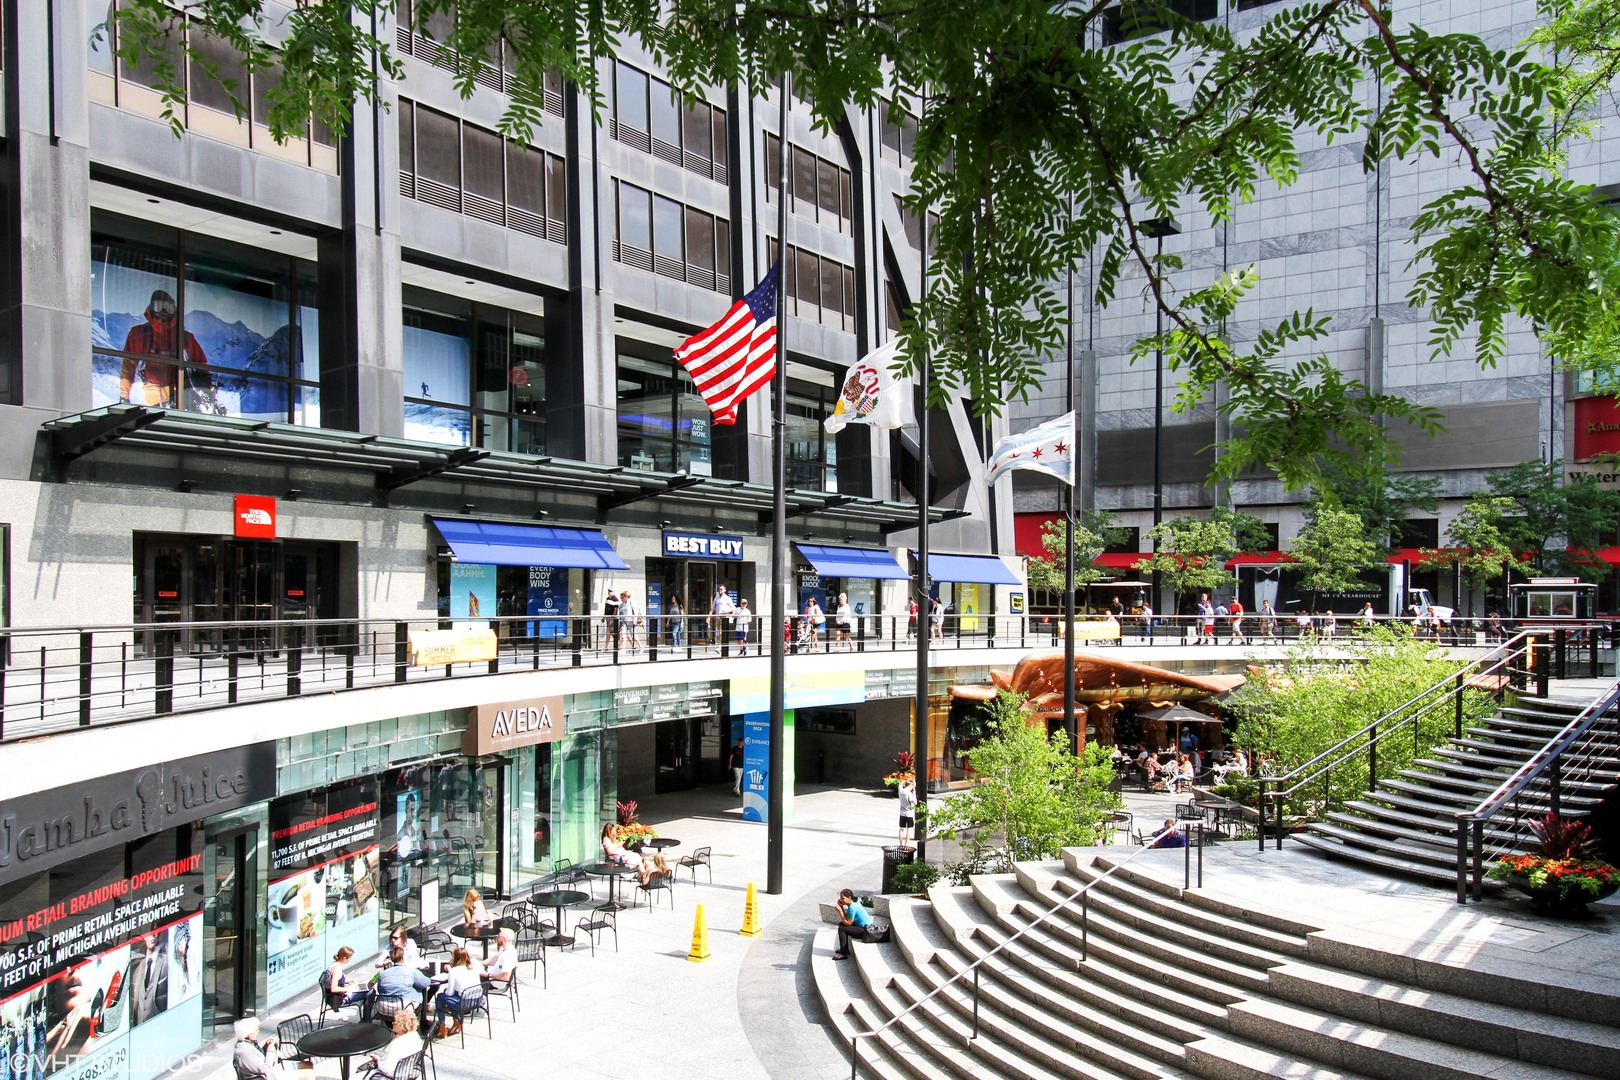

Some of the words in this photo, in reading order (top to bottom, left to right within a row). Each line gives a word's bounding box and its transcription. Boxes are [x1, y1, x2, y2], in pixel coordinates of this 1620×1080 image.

[667, 536, 707, 552] BEST
[710, 539, 742, 554] BUY
[530, 572, 550, 580] BODY
[530, 580, 550, 588] WINS
[425, 645, 456, 657] SUMMER
[615, 689, 649, 699] SOUVENIRS
[492, 704, 553, 738] AVEDA
[0, 795, 133, 867] Jamba
[165, 767, 250, 815] Juice
[272, 825, 298, 840] PREMIUM
[299, 820, 316, 833] RETAIL
[316, 812, 343, 826] BRANDING
[344, 802, 378, 818] OPPORTUNITY
[272, 847, 288, 859] 11,700
[298, 842, 305, 850] OF
[305, 836, 321, 847] PRIME
[321, 832, 337, 842] RETAIL
[338, 826, 354, 836] SPACE
[353, 818, 377, 832] AVAILABLE
[274, 860, 281, 869] 87
[281, 856, 293, 867] FEET
[294, 853, 301, 862] OF
[307, 843, 332, 857] MICHIGAN
[332, 836, 351, 849] AVENUE
[351, 829, 375, 842] FRONTAGE
[27, 902, 68, 932] RETAIL
[70, 879, 128, 914] BRANDING
[131, 854, 201, 890] OPPORTUNITY
[18, 944, 35, 963] S.F.
[37, 937, 51, 954] OF
[52, 924, 82, 948] PRIME
[84, 912, 113, 935] RETAIL
[114, 901, 141, 921] SPACE
[143, 884, 184, 910] AVAILABLE
[4, 965, 27, 988] FEET
[29, 958, 42, 975] OF
[56, 933, 102, 964] MICHIGAN
[104, 921, 137, 941] AVENUE
[138, 900, 179, 928] FRONTAGE
